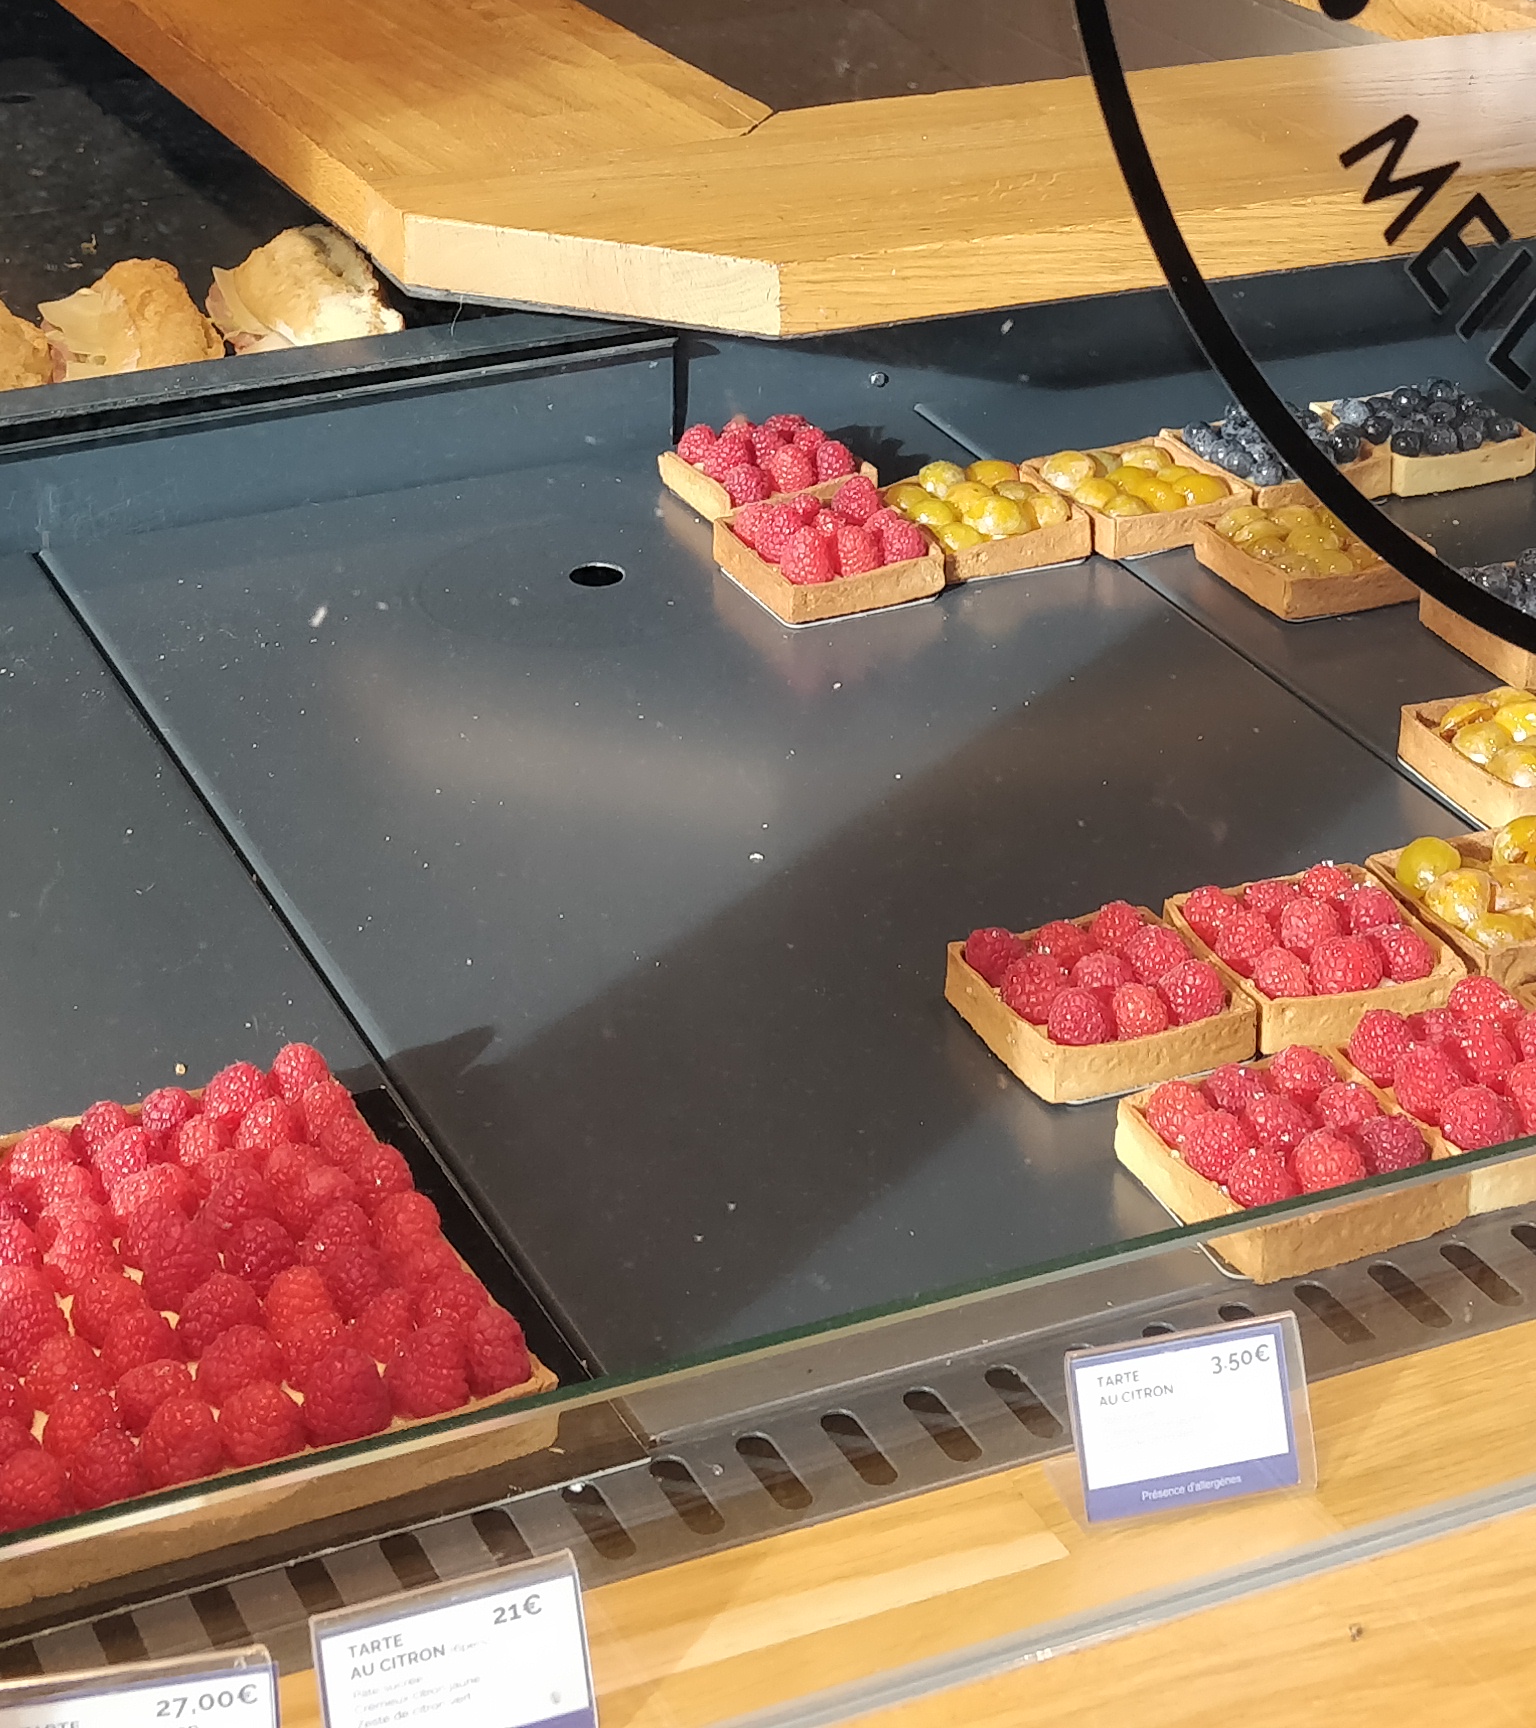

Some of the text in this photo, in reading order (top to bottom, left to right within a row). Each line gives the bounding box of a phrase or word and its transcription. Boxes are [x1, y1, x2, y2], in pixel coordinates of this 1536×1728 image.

[1097, 1370, 1141, 1388] TARTE
[1099, 1384, 1175, 1407] AU CITRON
[1142, 1485, 1185, 1502] Présence
[492, 1594, 543, 1625] 21€
[348, 1633, 404, 1659] TARTE
[351, 1663, 375, 1681] AU
[379, 1643, 447, 1673] CITRON
